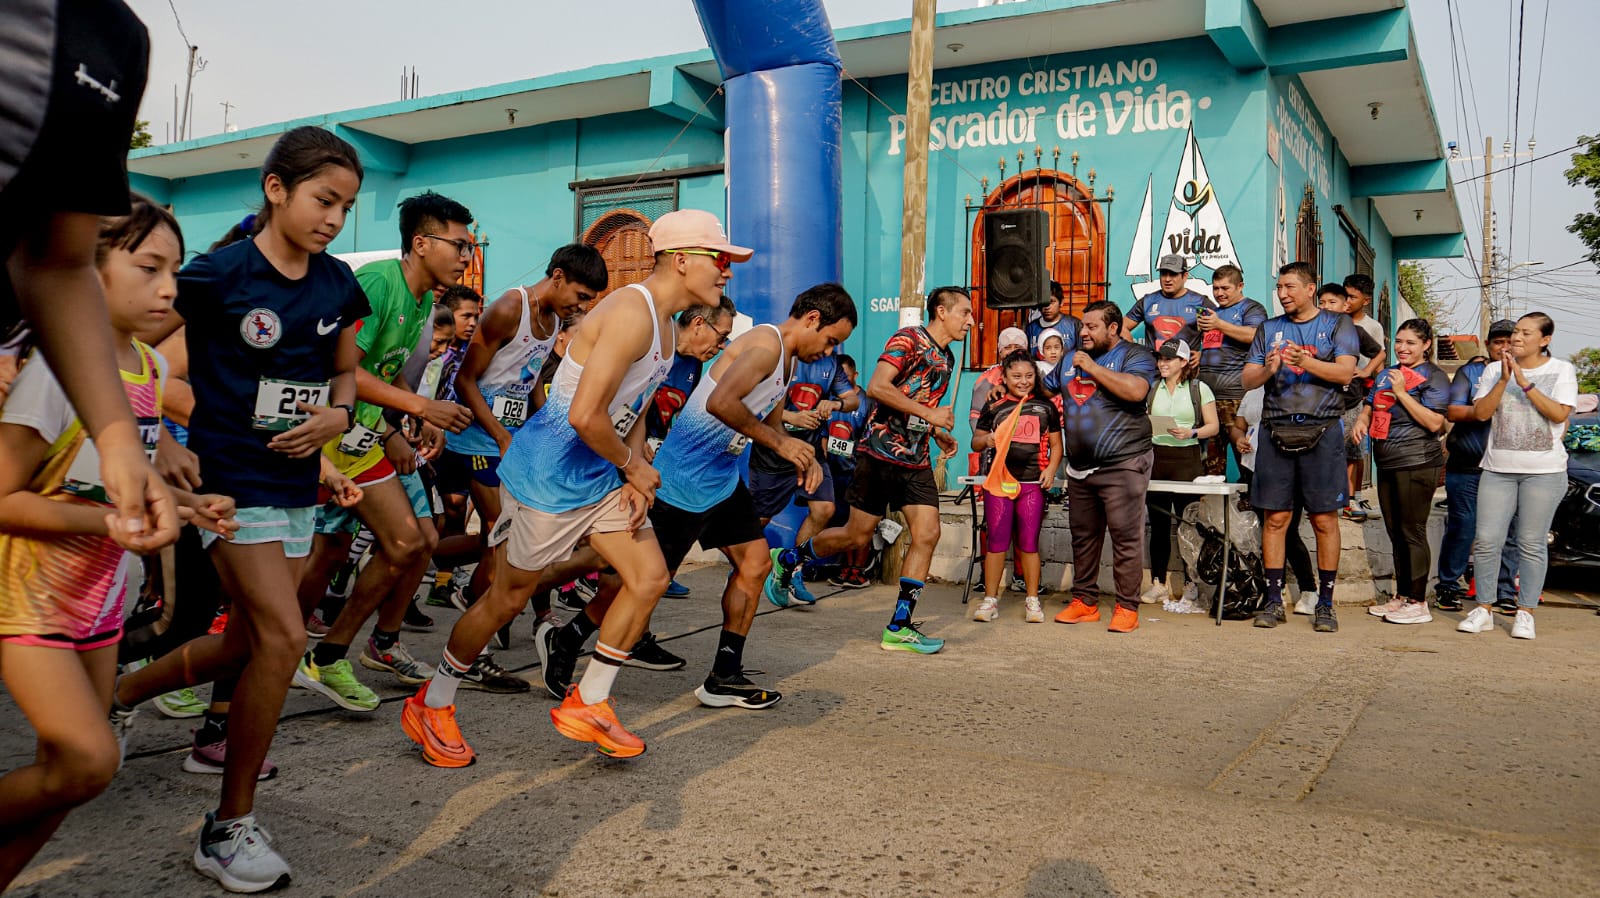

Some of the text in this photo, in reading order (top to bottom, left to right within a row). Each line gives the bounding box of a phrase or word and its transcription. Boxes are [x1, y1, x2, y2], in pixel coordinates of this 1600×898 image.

[931, 57, 1158, 107] CENTRO CRISTIANO
[887, 101, 1047, 156] Pscador
[1056, 94, 1097, 140] de
[503, 400, 524, 418] 028
[831, 439, 848, 452] 248
